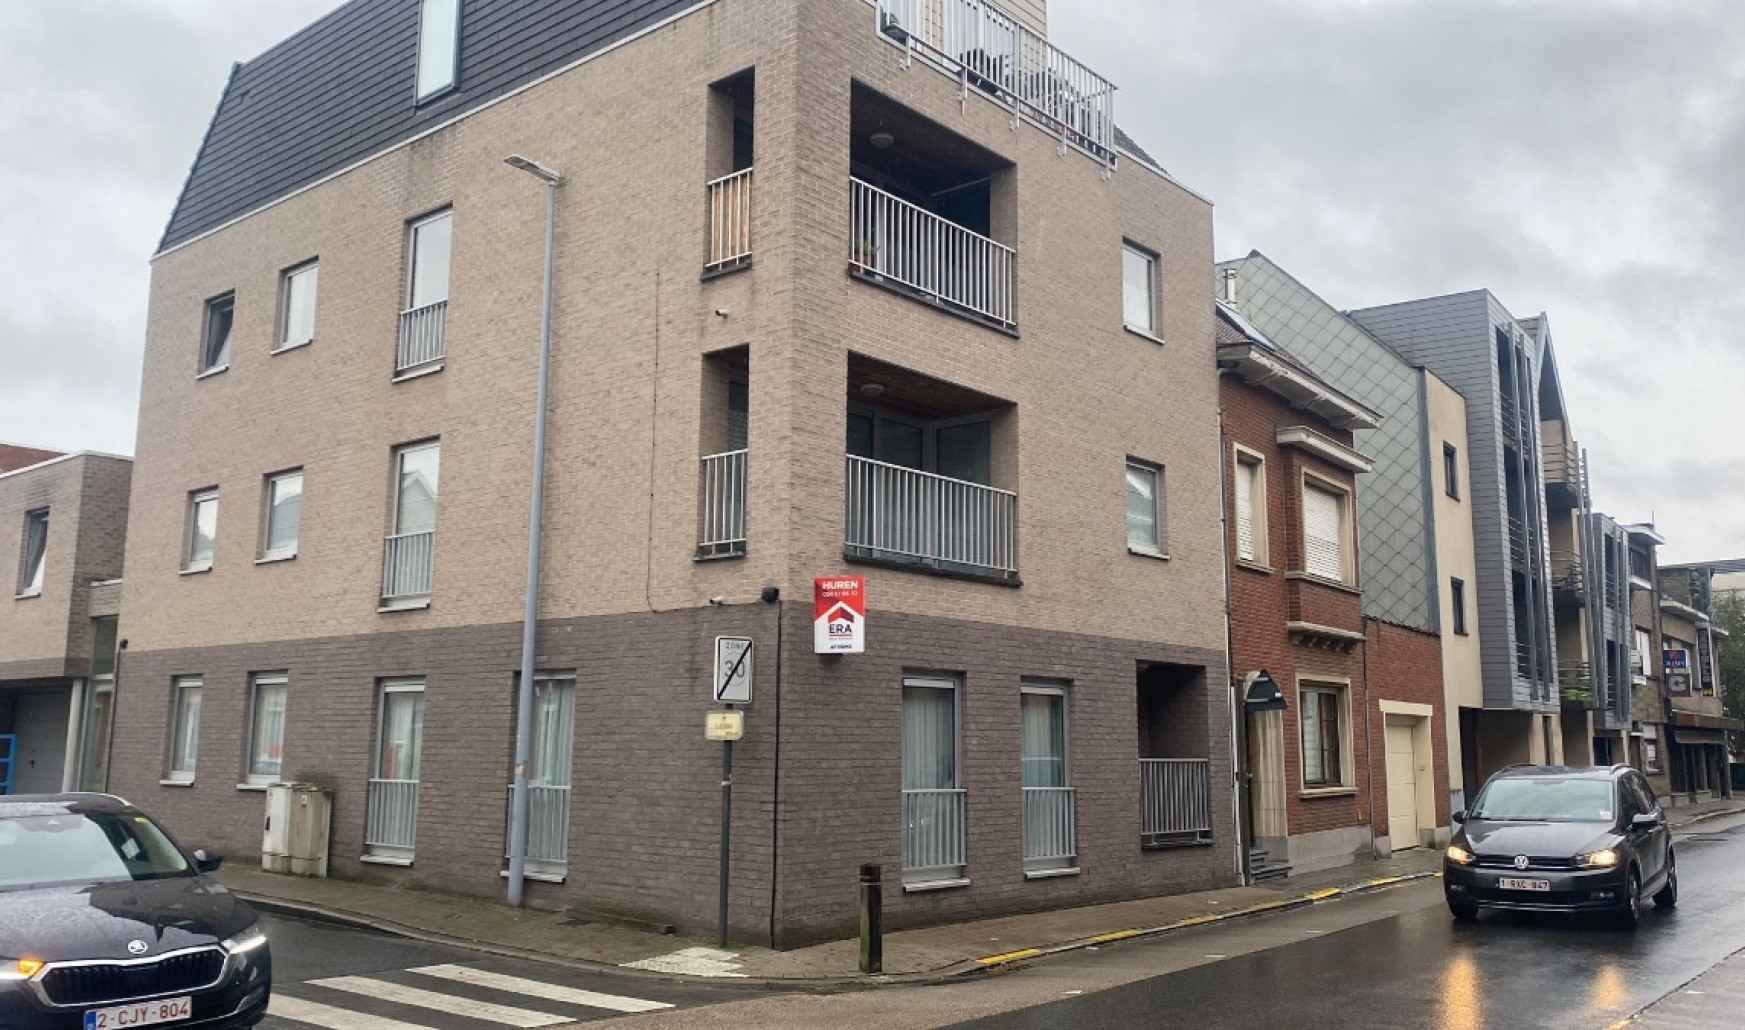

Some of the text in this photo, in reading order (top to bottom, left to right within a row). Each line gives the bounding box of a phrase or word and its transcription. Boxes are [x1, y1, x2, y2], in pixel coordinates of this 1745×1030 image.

[822, 580, 858, 590] HUREN
[829, 624, 852, 634] ERA
[724, 660, 746, 678] 30
[98, 1001, 188, 1028] 2-CJY-804
